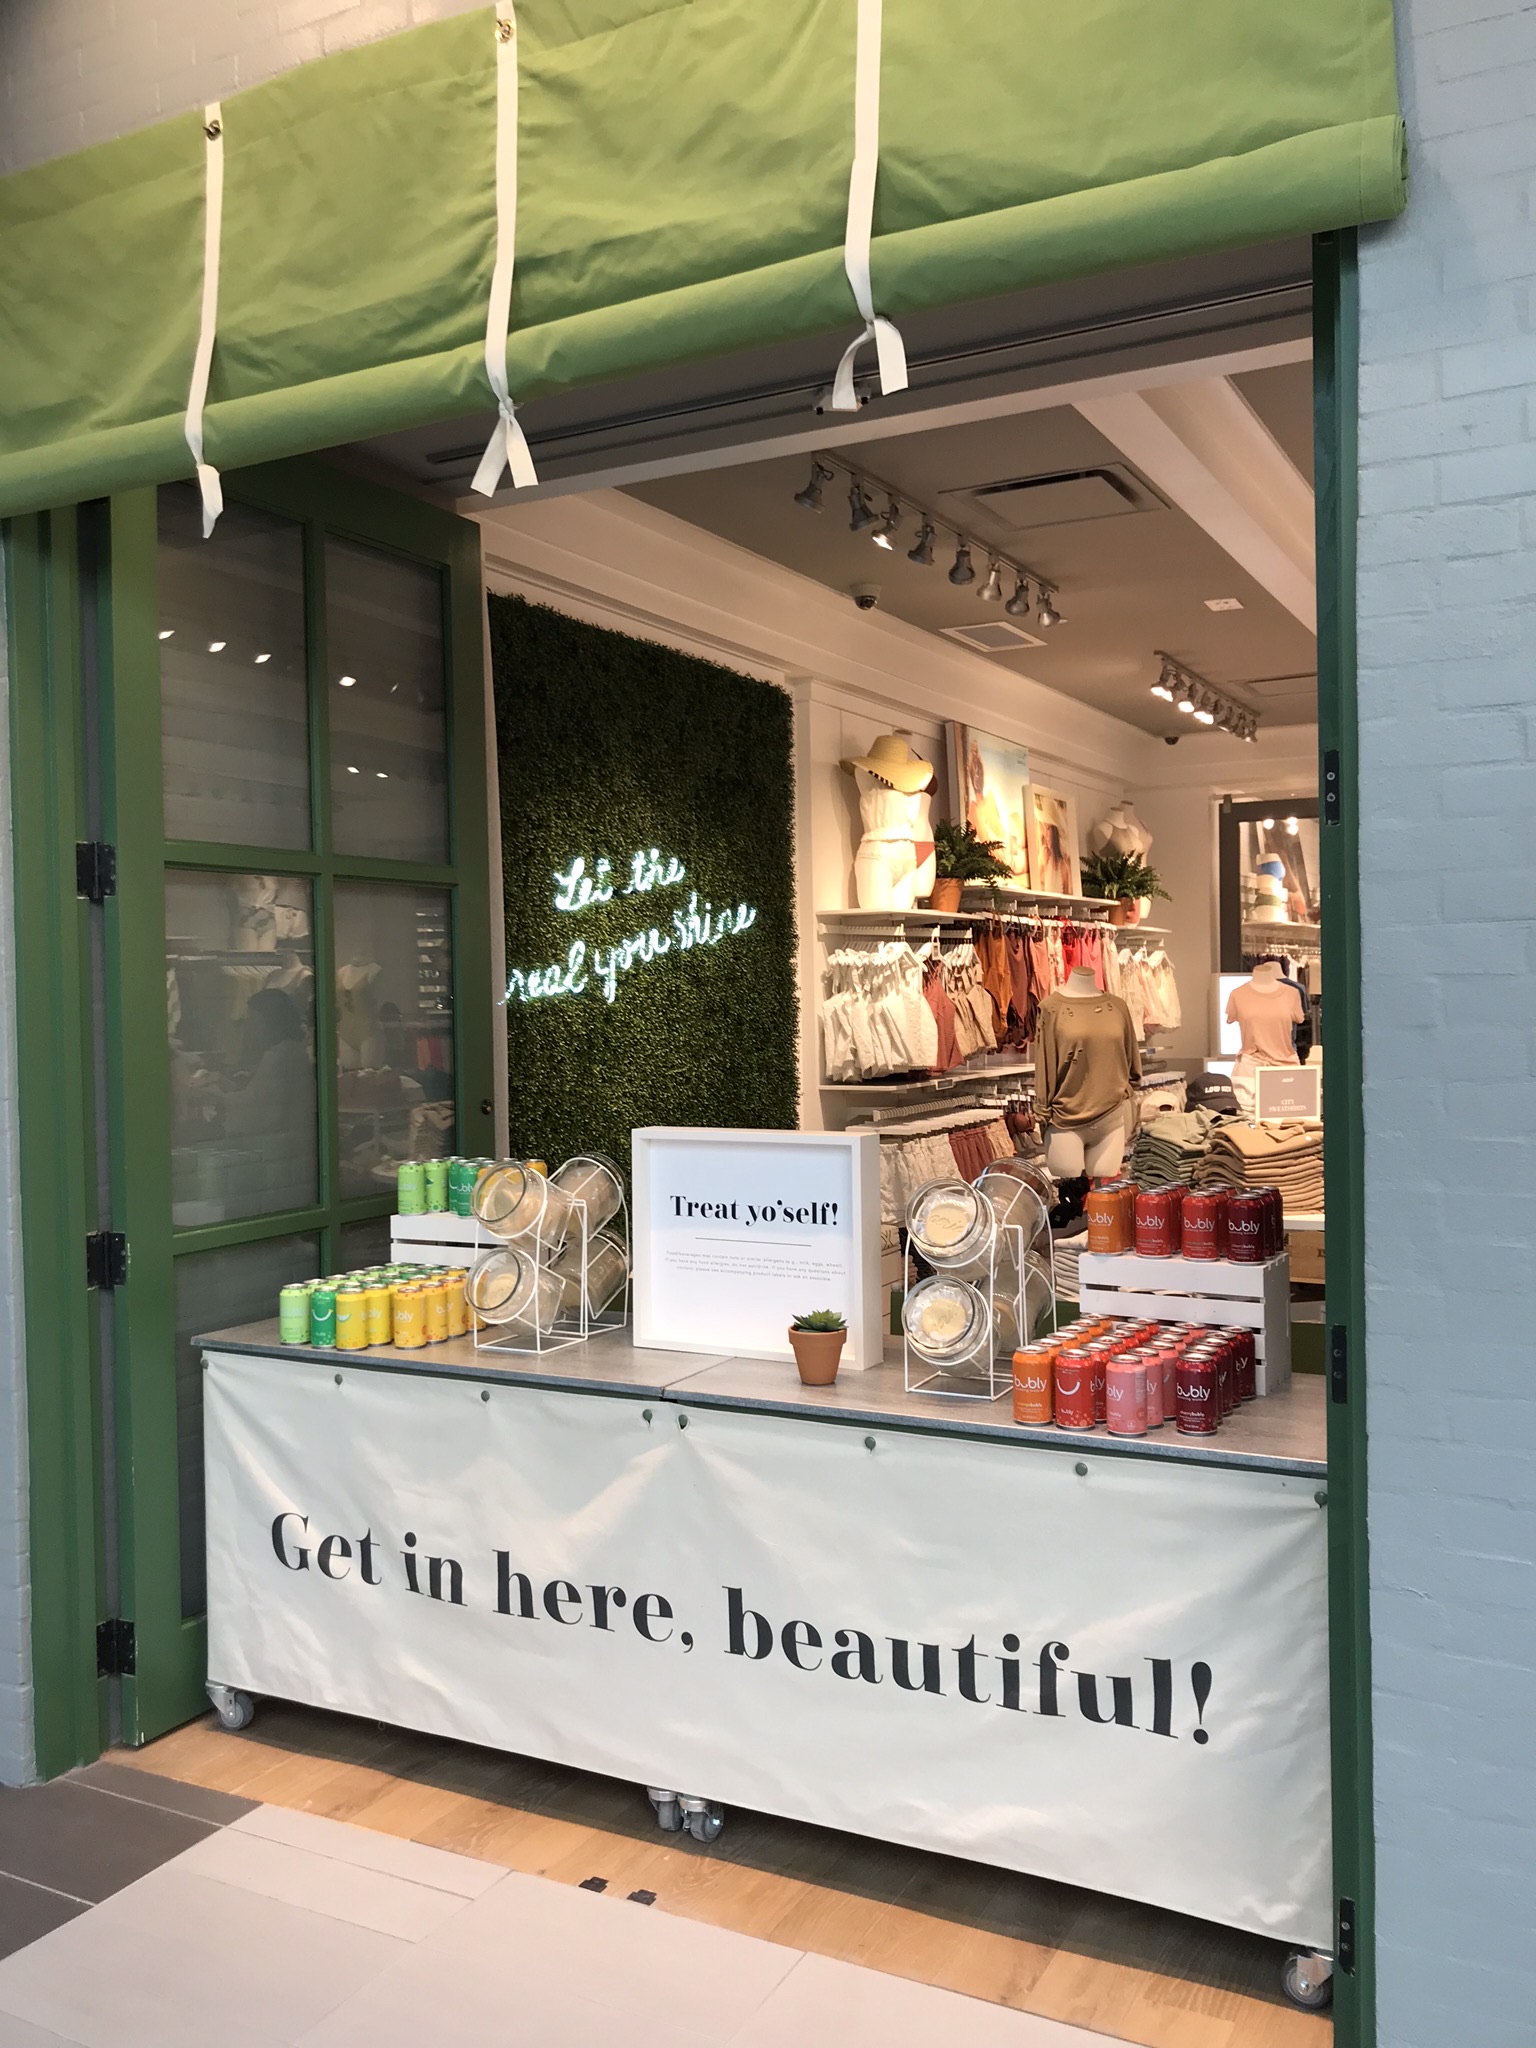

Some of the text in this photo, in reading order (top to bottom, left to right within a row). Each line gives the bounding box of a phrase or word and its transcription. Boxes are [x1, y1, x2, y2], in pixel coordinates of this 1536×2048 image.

[622, 848, 687, 895] the
[502, 891, 758, 1004] real you shine
[669, 1195, 741, 1221] Treat
[1183, 1216, 1215, 1232] bubly
[1228, 1218, 1260, 1235] bubly
[1014, 1374, 1048, 1392] bubly
[1176, 1382, 1211, 1402] bubly
[270, 1511, 1214, 1746] Get in here, beautiful!
